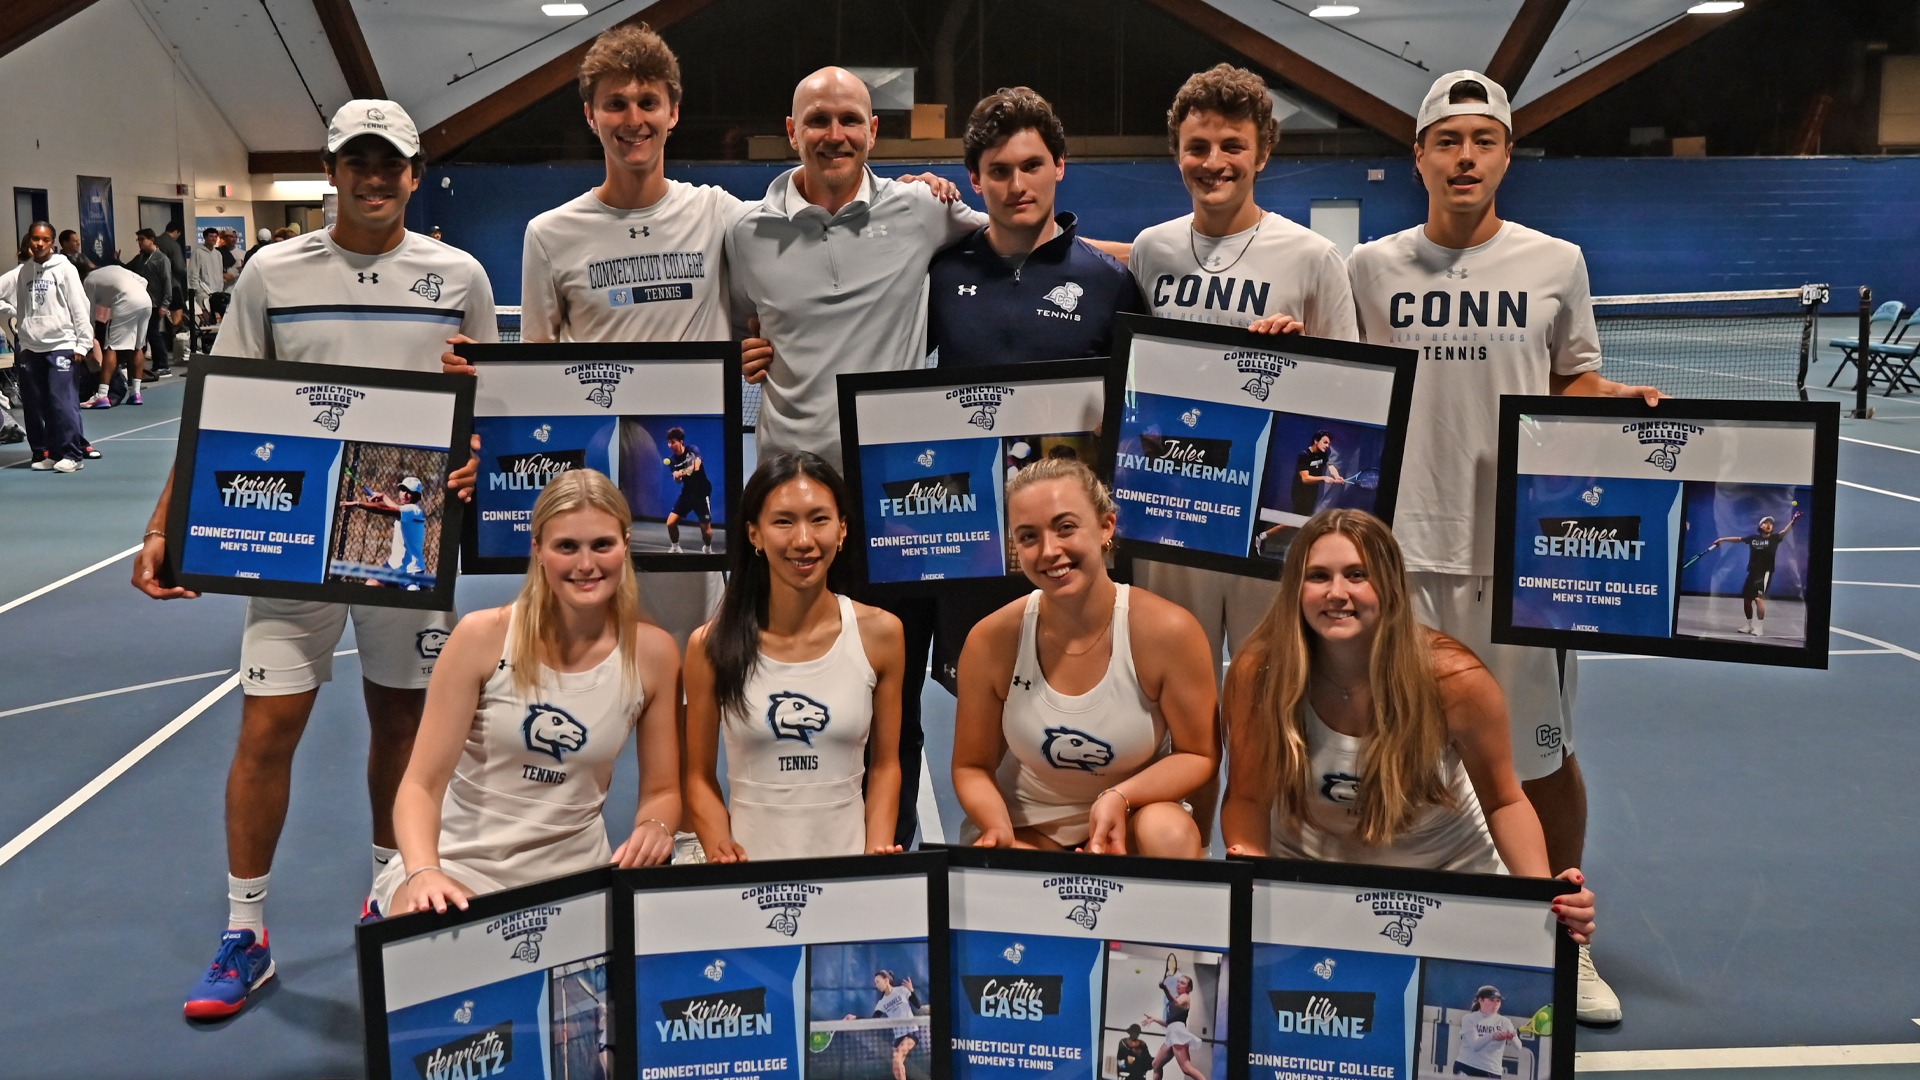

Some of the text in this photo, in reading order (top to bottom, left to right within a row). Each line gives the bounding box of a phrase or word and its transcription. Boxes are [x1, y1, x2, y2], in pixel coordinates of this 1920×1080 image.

[362, 123, 388, 131] TENNIS
[589, 252, 705, 289] CONNECTICUT COLLEGE
[644, 286, 682, 301] TENNIS
[1153, 274, 1270, 316] CONN
[1036, 308, 1081, 322] TENNIS
[1390, 291, 1527, 328] CONN
[1431, 333, 1478, 342] HEART
[1490, 333, 1525, 342] LEGS
[1224, 351, 1297, 369] CONNECTICUT
[1423, 346, 1487, 360] TENNIS
[564, 362, 634, 375] CONNECTICUT
[578, 371, 621, 380] COLLEGE
[1237, 360, 1283, 373] COLLEGE
[296, 385, 366, 400] CONNECTICUT
[309, 393, 352, 404] COLLEGE
[946, 386, 1015, 400] CONNECTICUT
[959, 393, 1002, 404] COLLEGE
[1622, 421, 1705, 436] CONNECTICUT
[1638, 430, 1688, 441] COLLEGE
[1159, 439, 1206, 463] Jules
[513, 453, 572, 477] Walker
[1116, 452, 1250, 486] TAYLOR-KERMAN
[489, 471, 562, 491] MULLI
[222, 487, 293, 512] TIPNIS
[906, 481, 948, 502] Andy
[879, 493, 977, 517] FELDMAN
[1116, 488, 1241, 517] CONNECTICUT COLLEGE
[482, 510, 534, 521] CONNECT
[1145, 506, 1208, 524] MEN'S TENNIS
[190, 525, 316, 545] CONNECTICUT COLLEGE
[870, 531, 990, 547] CONNECTICUT COLLEGE
[1557, 520, 1618, 544] James
[220, 541, 283, 554] MEN'S TENNIS
[901, 545, 961, 556] MEN'S TENNIS
[1533, 535, 1646, 561] SERHANT
[1519, 576, 1658, 596] CONNECTICUT COLLEGE
[1553, 592, 1622, 606] MEN'S TENNIS
[1536, 724, 1561, 749] CC
[778, 755, 819, 771] TENNIS
[523, 764, 567, 785] TENNIS
[742, 883, 823, 900] CONNECTICUT
[1043, 876, 1124, 893] CONNECTICUT
[1058, 885, 1108, 898] COLLEGE
[757, 893, 808, 905] COLLEGE
[1356, 891, 1442, 909] CONNECTICUT
[1372, 901, 1425, 914] COLLEGE
[486, 907, 561, 935] CONNECTICUT
[502, 916, 548, 936] COLLEGE
[983, 978, 1043, 1004] Caitlin
[681, 999, 742, 1026] Kinley
[980, 995, 1043, 1022] CASS
[1301, 995, 1338, 1025] Lily
[655, 1013, 772, 1043] YANGDEN
[1278, 1009, 1366, 1039] DUNNE
[425, 1030, 504, 1075] Henrietta
[951, 1038, 1081, 1060] ONNECTICUT COLLEGE
[642, 1057, 788, 1080] CONNECTICUT COLLEGE
[968, 1054, 1054, 1071] WOMEN'S TENNIS
[1248, 1052, 1395, 1079] CONNECTICUT COLLEGE
